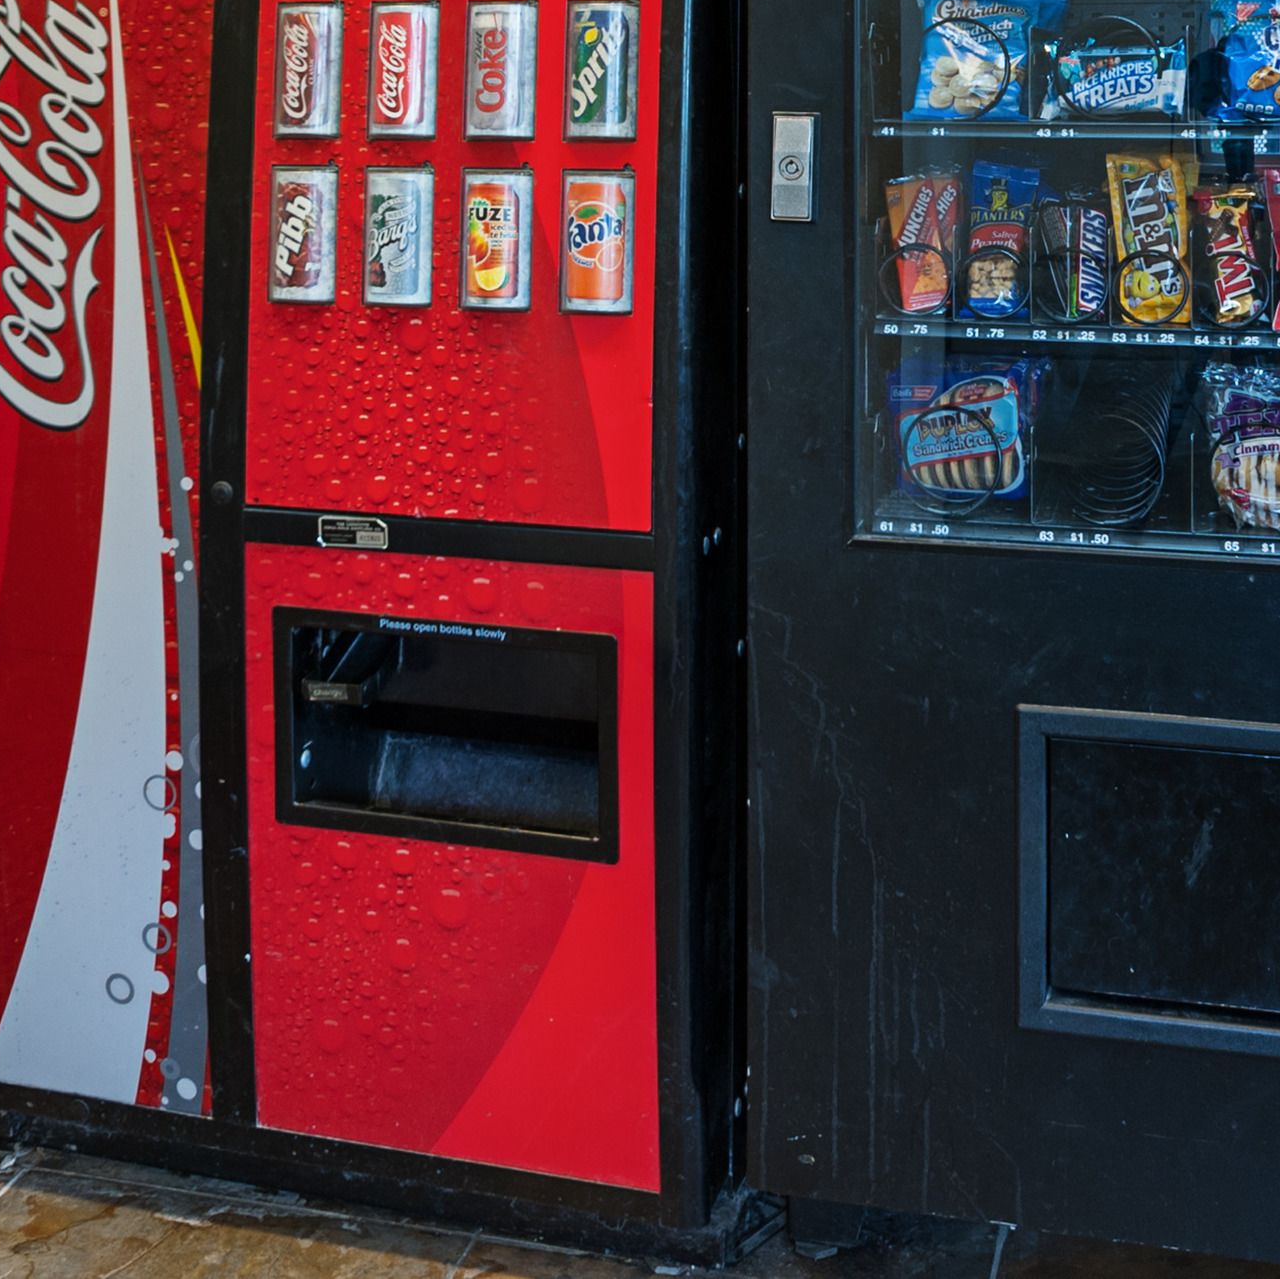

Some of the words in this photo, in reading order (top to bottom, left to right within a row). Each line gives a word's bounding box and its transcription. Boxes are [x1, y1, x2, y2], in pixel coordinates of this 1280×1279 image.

[377, 20, 407, 119] Coca-Cola
[1073, 76, 1099, 95] RICE
[1100, 61, 1154, 85] KRISPIES
[1075, 76, 1157, 109] TREATS
[468, 206, 512, 222] FUZE
[969, 208, 1026, 224] PLANTERS
[275, 195, 313, 277] Pibb
[991, 230, 1018, 239] Salted
[970, 238, 1018, 250] Peanuts
[1078, 208, 1107, 311] SNICKERS
[883, 324, 898, 334] 50
[910, 324, 928, 334] .75
[966, 327, 980, 338] 51
[986, 328, 1005, 338] .75
[1032, 330, 1047, 340] 52
[1077, 331, 1096, 342] .25
[1112, 332, 1127, 343] 53
[1156, 333, 1175, 344] .25
[912, 436, 966, 457] Sandwich
[965, 430, 1008, 449] Cremes
[880, 521, 894, 533] 61
[910, 522, 923, 534] $1
[931, 524, 949, 536] .50
[1039, 530, 1054, 542] 63
[1070, 532, 1084, 543] $1
[1090, 534, 1110, 545] .50
[1224, 541, 1240, 552] 65
[1261, 543, 1276, 554] $1
[379, 618, 411, 631] Please
[413, 622, 438, 634] open
[439, 623, 472, 636] bottles
[475, 628, 506, 641] slowly
